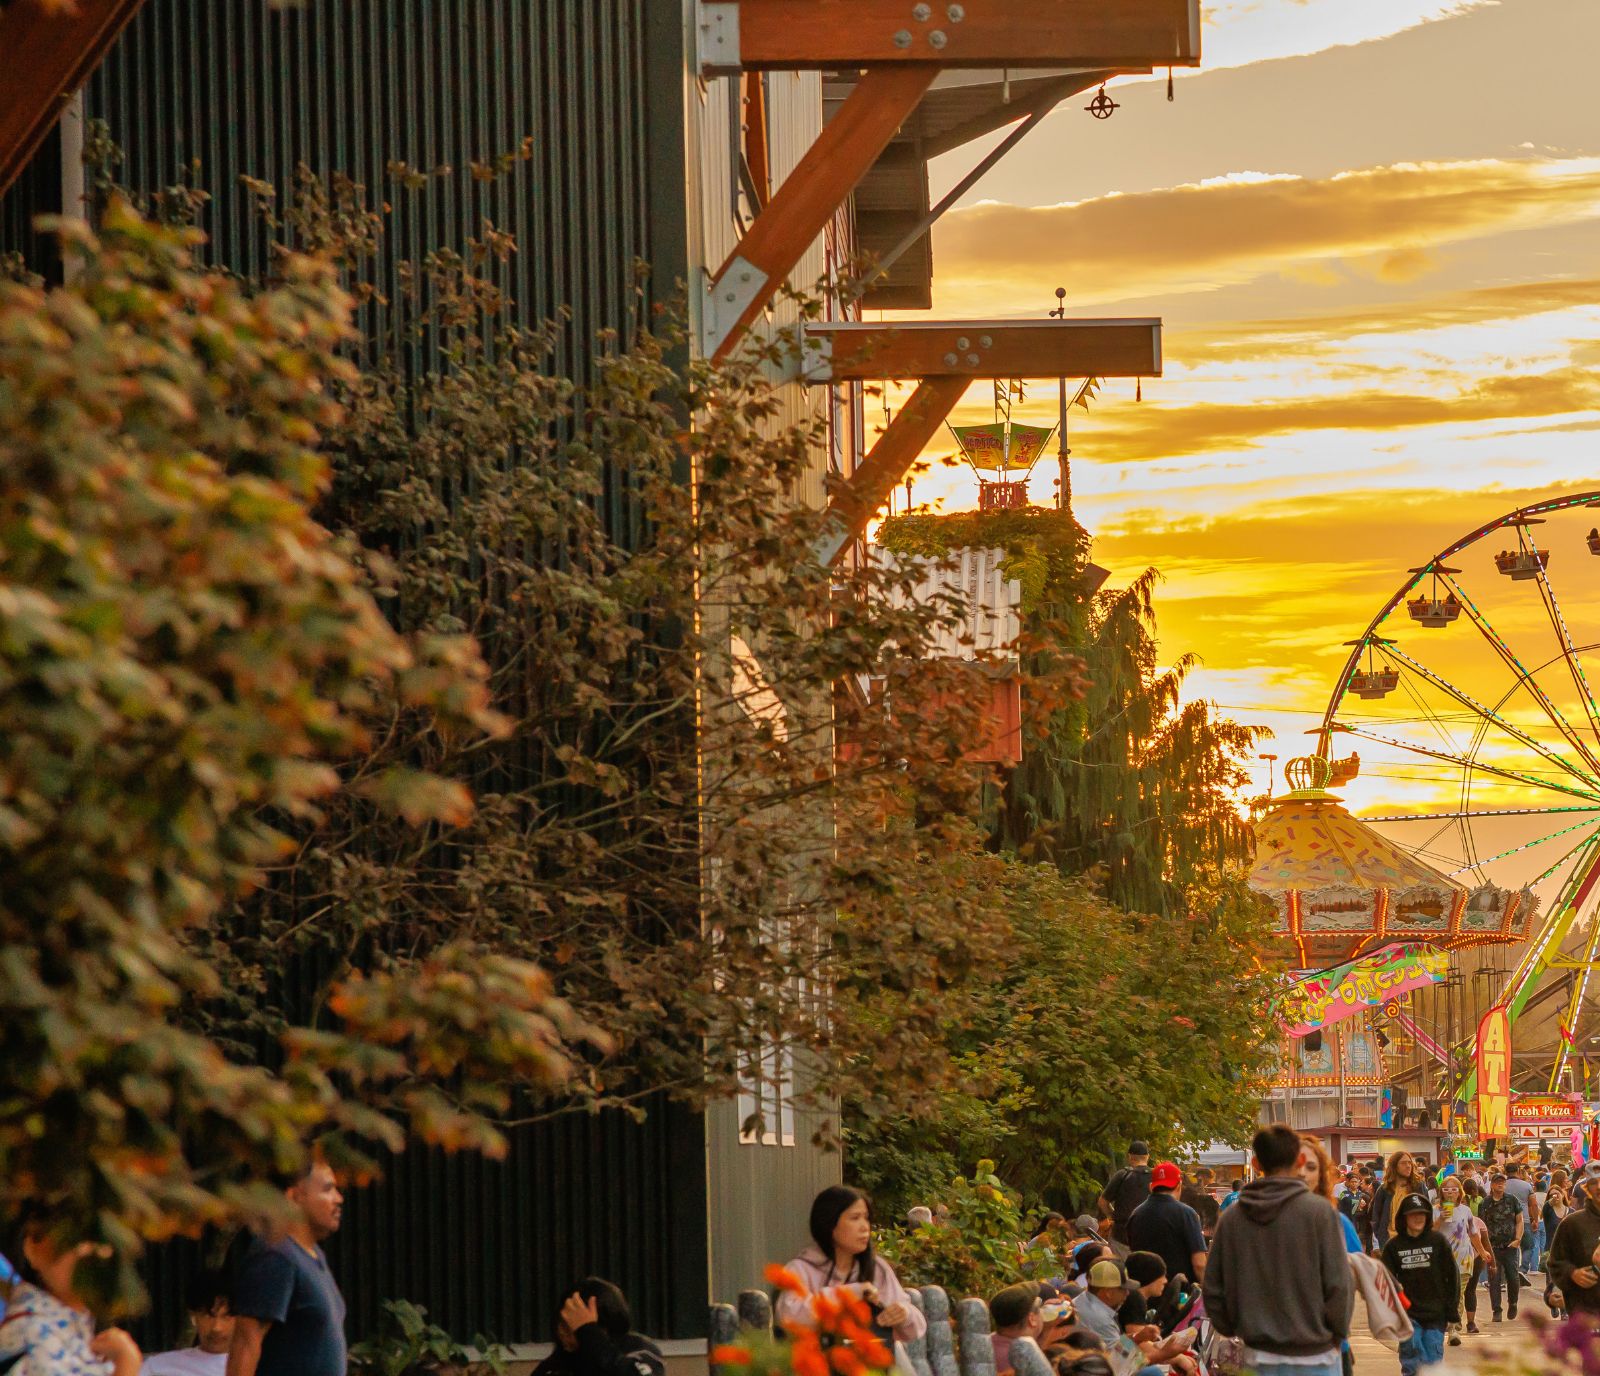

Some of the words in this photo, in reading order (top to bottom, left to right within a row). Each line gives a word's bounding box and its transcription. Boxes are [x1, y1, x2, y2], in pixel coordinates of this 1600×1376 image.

[1479, 1012, 1508, 1135] ATM
[1511, 1105, 1540, 1116] Fresh
[1542, 1105, 1570, 1116] Pizza
